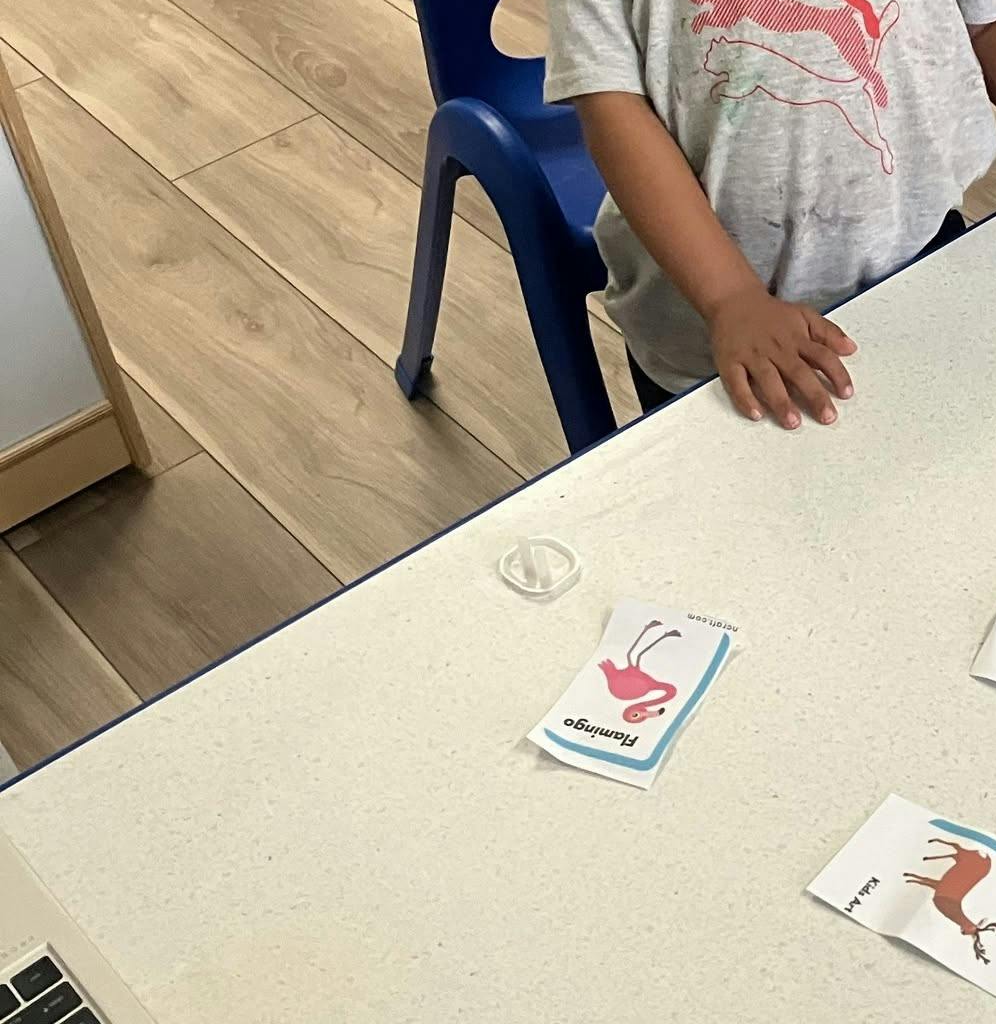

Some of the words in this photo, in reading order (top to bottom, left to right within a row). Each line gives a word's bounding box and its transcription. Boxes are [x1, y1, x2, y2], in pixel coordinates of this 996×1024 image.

[563, 718, 639, 747] Flamingo
[858, 876, 881, 896] Kids
[844, 895, 862, 913] Art
